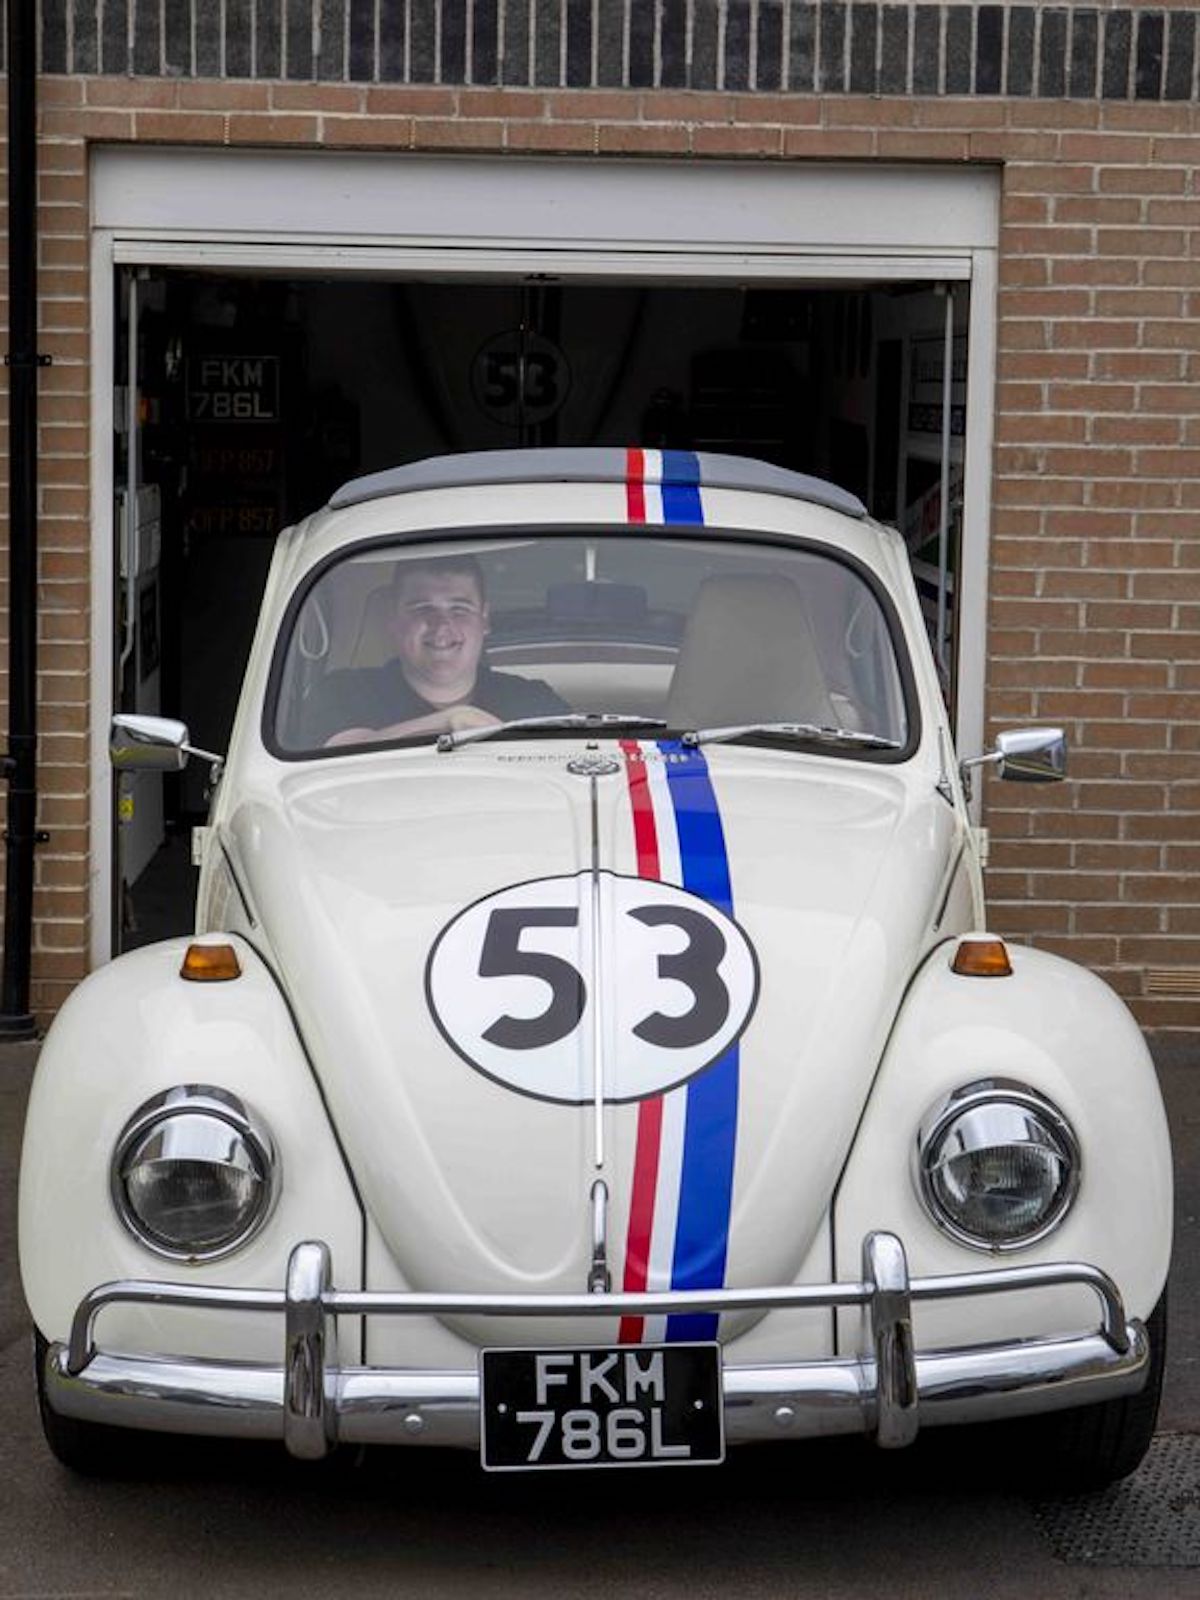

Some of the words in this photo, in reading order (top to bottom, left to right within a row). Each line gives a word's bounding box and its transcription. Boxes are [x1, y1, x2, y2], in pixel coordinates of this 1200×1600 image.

[202, 360, 263, 387] FKM
[485, 351, 557, 407] 53
[191, 392, 274, 418] 786L
[478, 904, 730, 1050] 53
[535, 1352, 665, 1405] FKM
[515, 1407, 691, 1462] 786L
